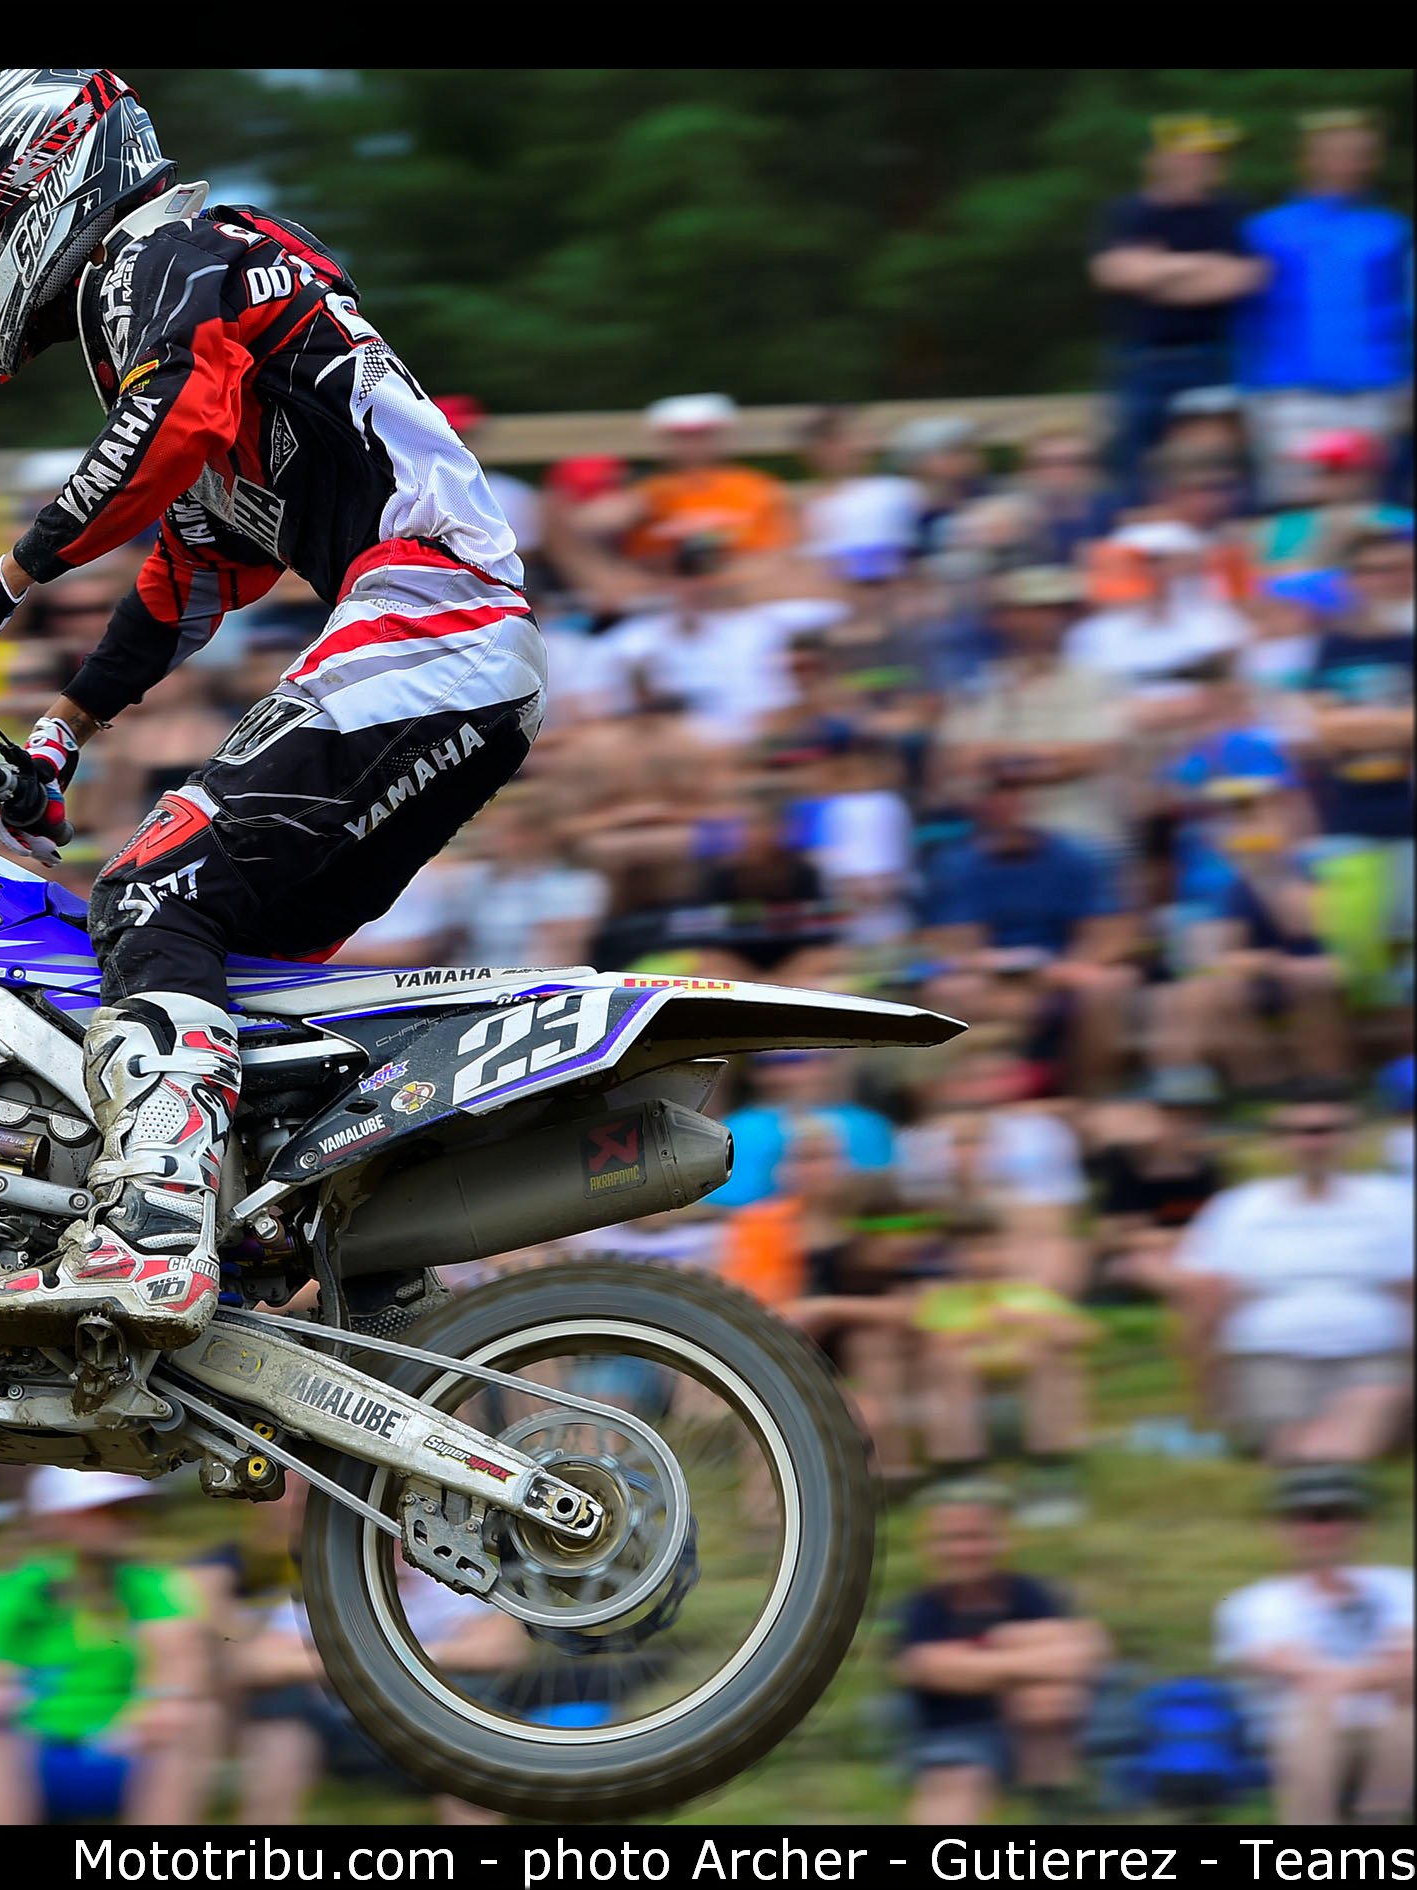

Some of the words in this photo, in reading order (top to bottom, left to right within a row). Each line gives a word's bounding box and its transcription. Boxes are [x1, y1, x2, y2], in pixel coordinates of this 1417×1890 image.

[56, 394, 163, 525] YAMAHA
[273, 419, 283, 466] CONTACT
[343, 721, 486, 842] YAMAHA
[393, 966, 493, 989] YAMAHA
[452, 988, 616, 1105] 23
[359, 1062, 410, 1094] VERTEX
[318, 1114, 386, 1155] YAMALUBE
